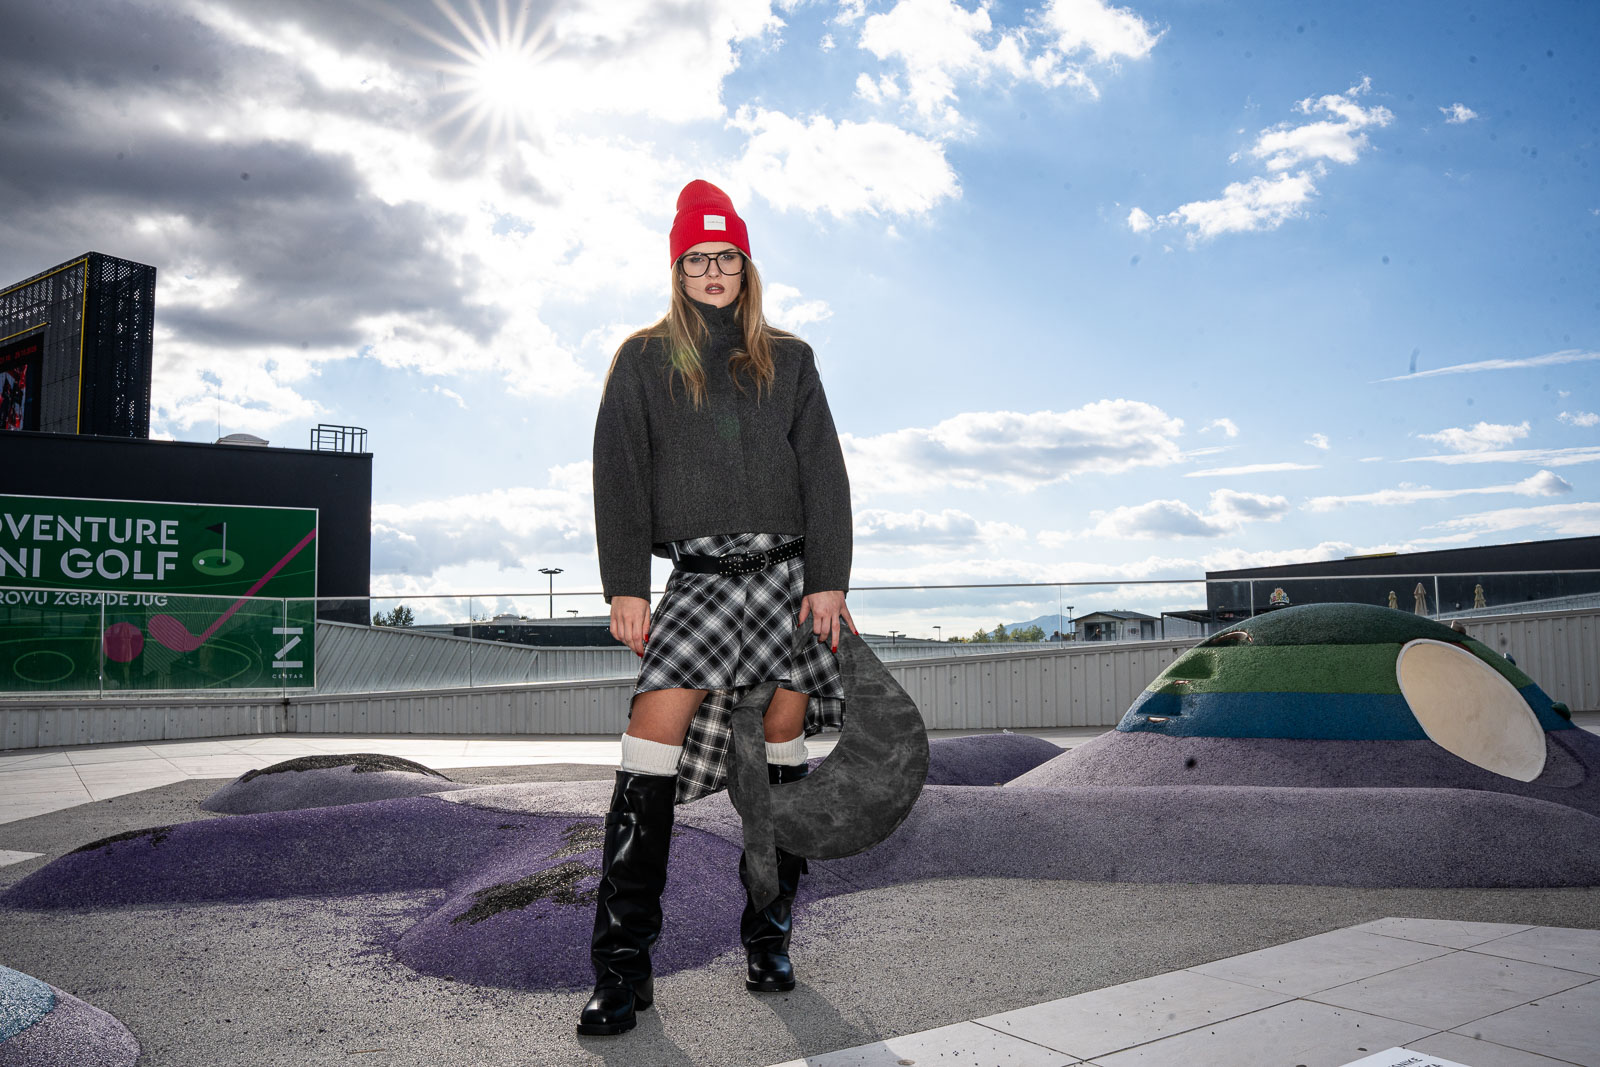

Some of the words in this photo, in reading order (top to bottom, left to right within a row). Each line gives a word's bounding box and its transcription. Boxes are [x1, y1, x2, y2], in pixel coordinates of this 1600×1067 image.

[0, 513, 179, 545] VENTURE
[60, 547, 179, 580] GOLF
[53, 591, 129, 606] ZGRADE
[133, 593, 168, 607] JUG
